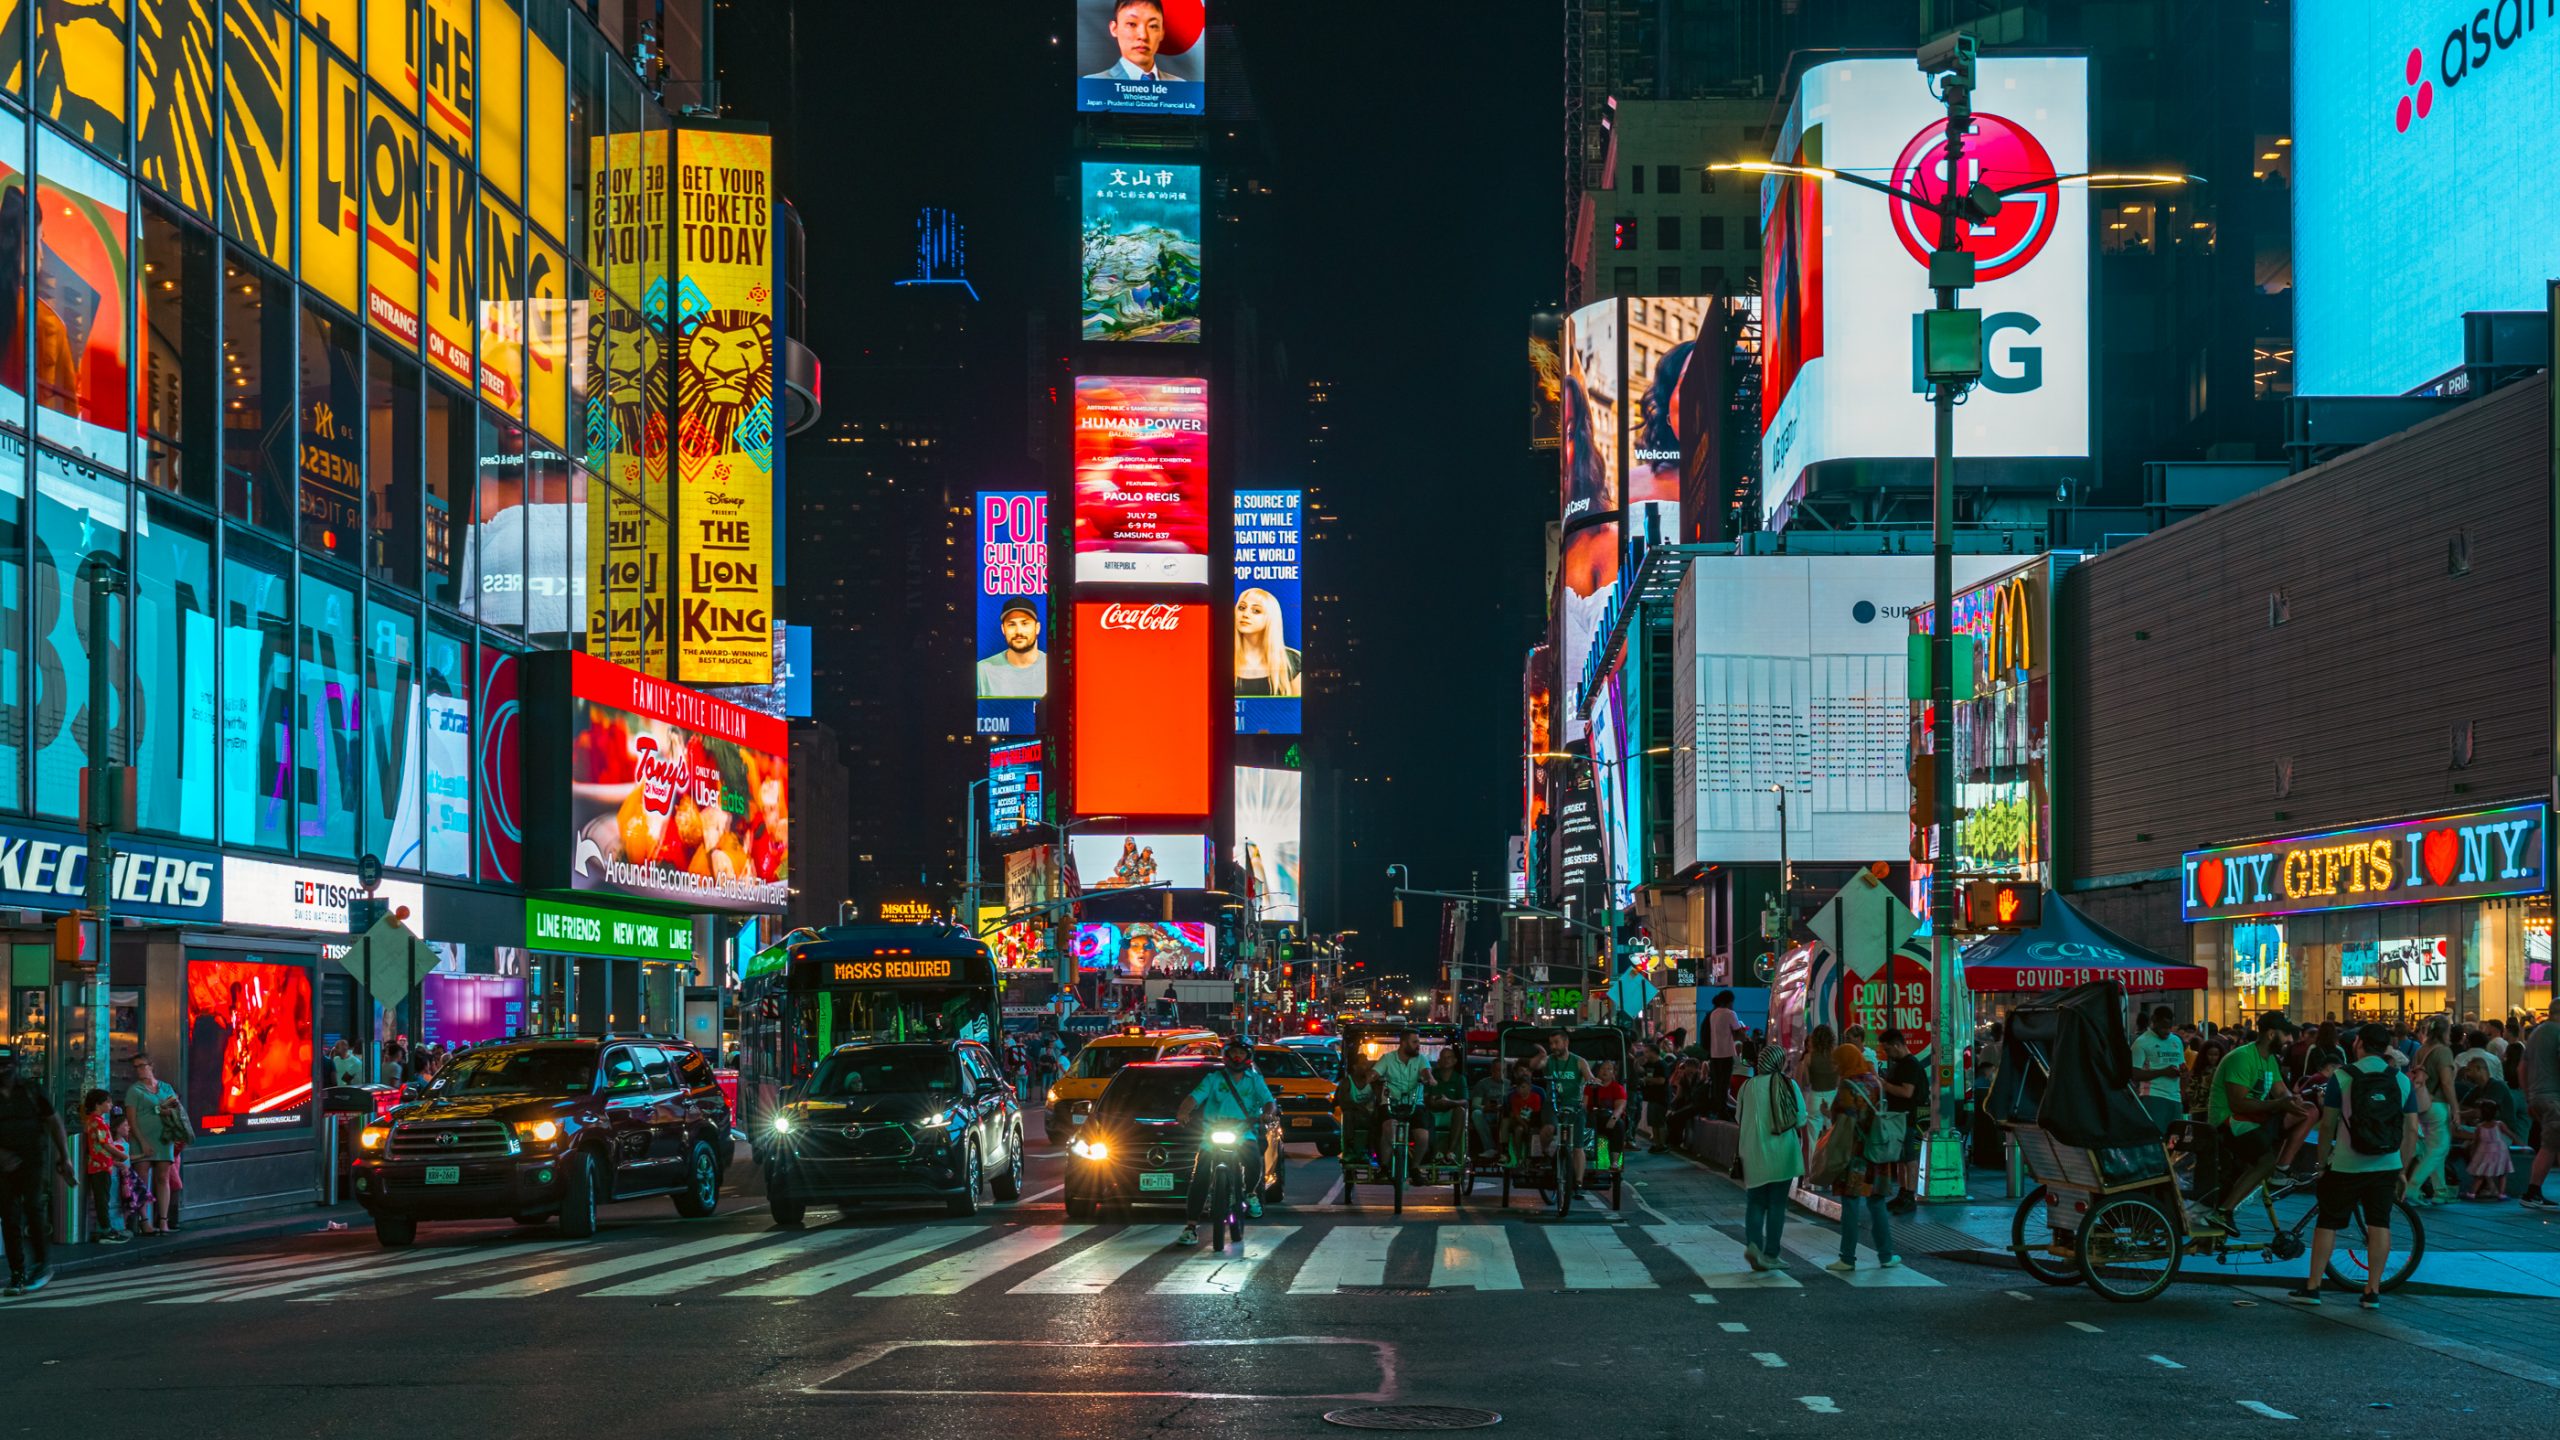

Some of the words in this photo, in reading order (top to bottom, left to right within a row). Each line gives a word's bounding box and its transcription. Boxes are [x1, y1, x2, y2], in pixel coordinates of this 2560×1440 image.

[2442, 0, 2556, 88] asa
[1114, 83, 1149, 93] Tsuneo
[1152, 85, 1168, 94] Ide
[317, 12, 439, 264] LION
[683, 165, 713, 191] GET
[720, 168, 764, 195] YOUR
[1108, 169, 1174, 188] 文山市
[683, 192, 766, 226] TICKETS
[683, 224, 766, 266] TODAY
[371, 293, 417, 338] ENTRANCE
[430, 333, 444, 356] ON
[449, 347, 469, 373] 45TH
[481, 367, 504, 396] STREET
[1082, 418, 1139, 429] HUMAN
[1145, 418, 1201, 430] POWER
[1634, 449, 1680, 460] Welcom
[1103, 492, 1143, 502] PAOLO
[1146, 493, 1180, 502] REGIS
[1243, 496, 1283, 508] SOURCE
[1286, 496, 1300, 508] OF
[1260, 513, 1293, 526] WHILE
[699, 520, 749, 543] THE
[1234, 530, 1275, 544] IGATING
[1277, 530, 1298, 544] THE
[1104, 561, 1136, 570] ARTREPUBLIC
[1234, 548, 1256, 562] ANE
[1258, 548, 1296, 562] WORLD
[690, 553, 757, 593] LION
[1253, 566, 1298, 580] CULTURE
[682, 598, 767, 643] KING
[1100, 603, 1183, 630] Coca-Cola
[700, 649, 768, 657] AWARD-WINNING
[632, 678, 706, 727] FAMILY-STYLE
[710, 703, 746, 739] ITALIAN
[635, 736, 690, 791] Tony's
[696, 765, 709, 777] ONLY
[711, 769, 719, 780] ON
[695, 779, 720, 808] Uber
[721, 785, 745, 815] Eats
[605, 853, 648, 888] Around
[649, 858, 667, 885] the
[667, 866, 700, 894] corner
[702, 874, 713, 895] on
[715, 871, 736, 900] 43rd
[748, 876, 755, 900] &
[755, 878, 770, 903] 7th
[770, 885, 787, 906] ave.
[2284, 838, 2393, 899] GIFTS
[537, 912, 560, 938] LINE
[562, 916, 600, 942] FRIENDS
[613, 922, 634, 945] NEW
[636, 925, 658, 947] YORK
[669, 929, 687, 949] LINE
[834, 963, 882, 980] MASKS
[885, 960, 951, 977] REQUIRED
[2016, 969, 2090, 987] COVID-19
